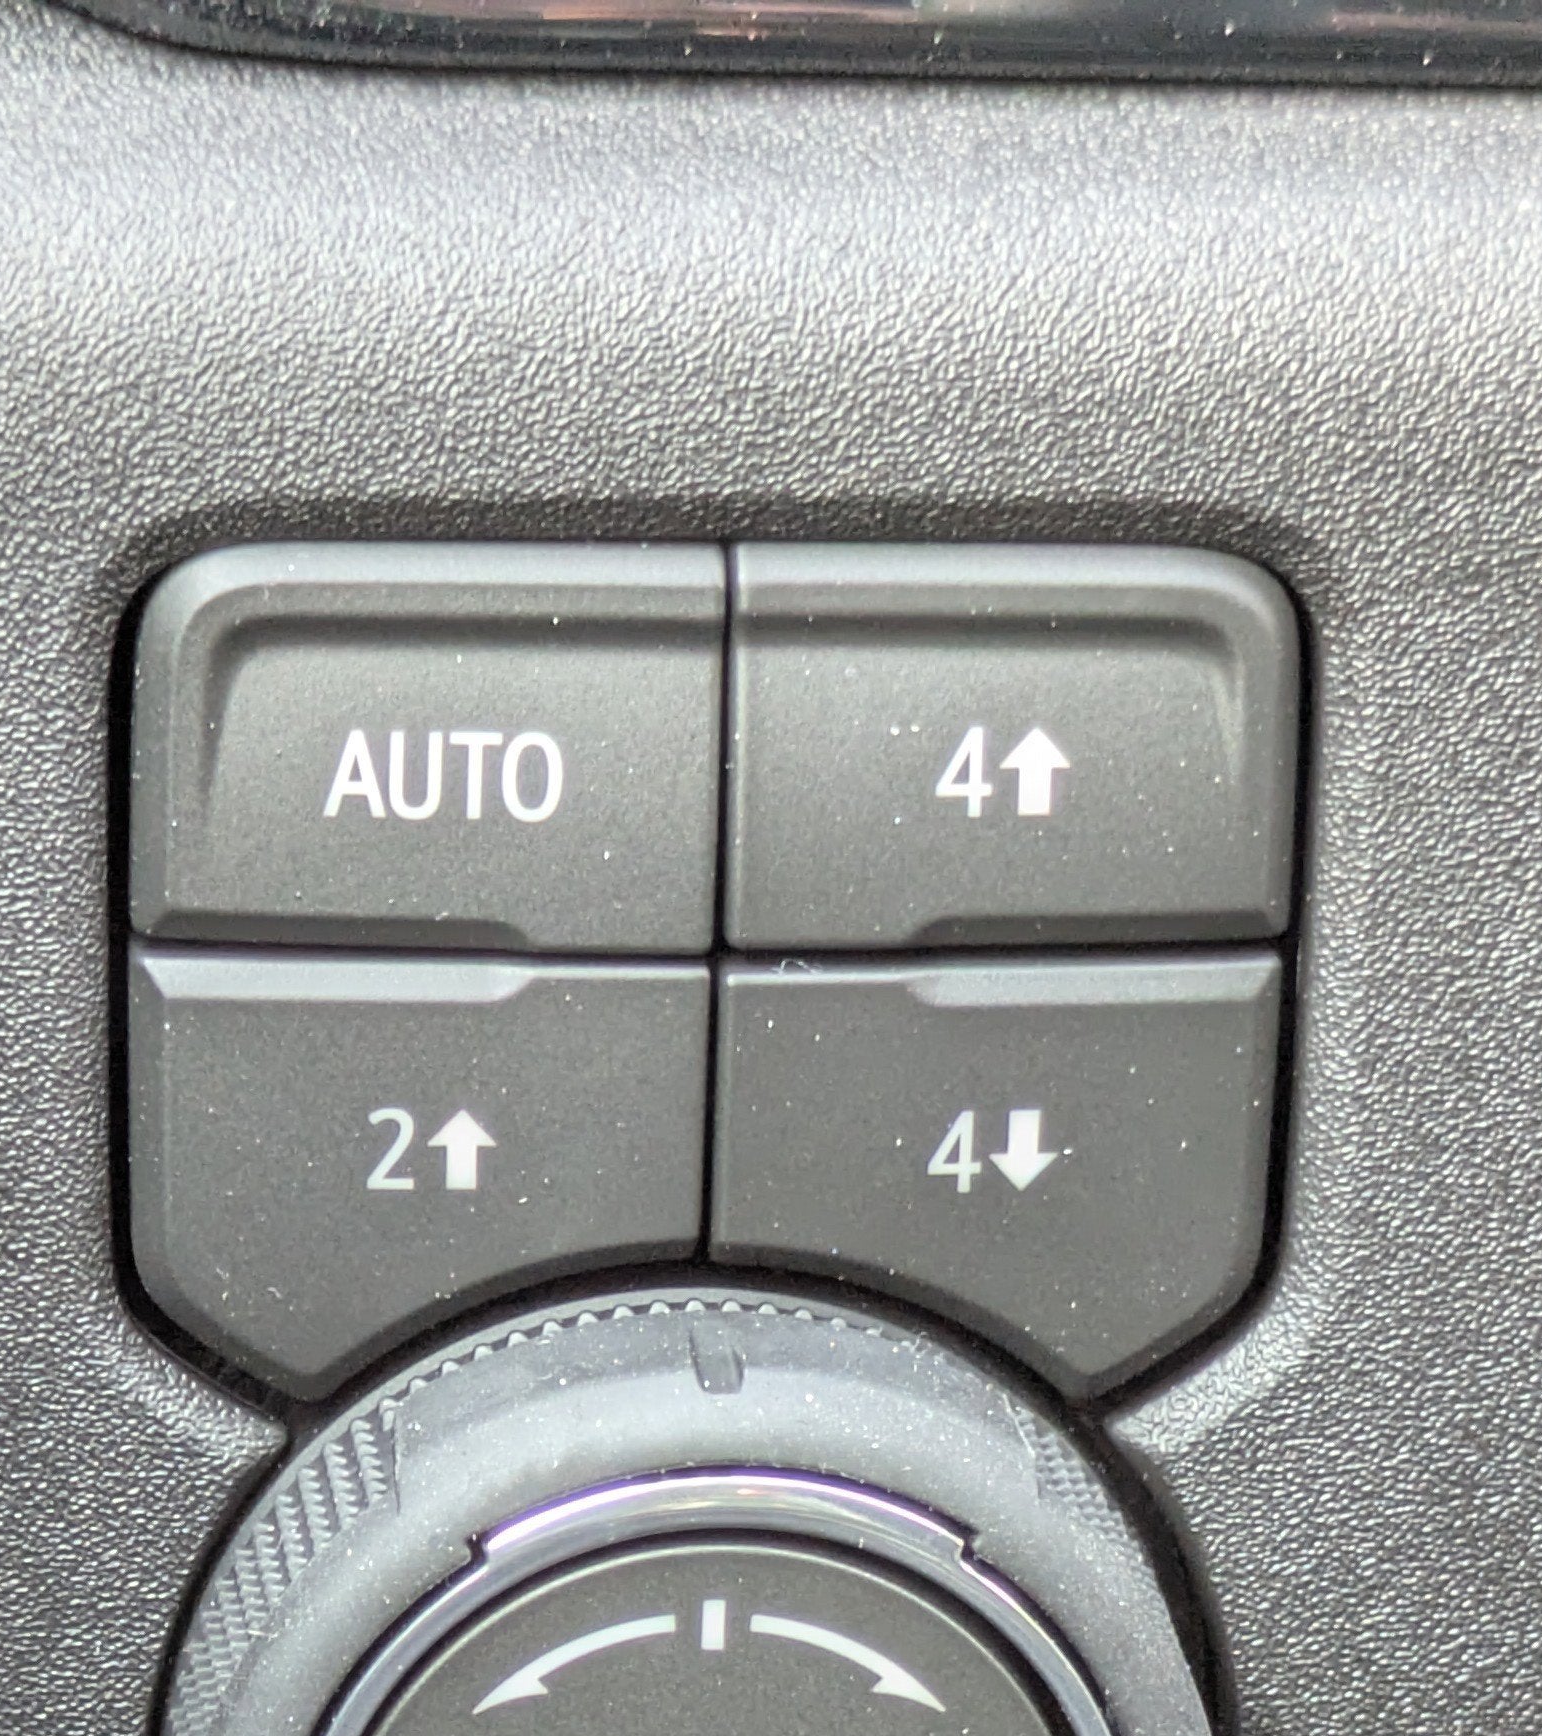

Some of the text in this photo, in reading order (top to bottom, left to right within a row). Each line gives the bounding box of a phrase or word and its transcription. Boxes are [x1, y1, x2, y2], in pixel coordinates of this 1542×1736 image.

[323, 728, 565, 823] AUTO
[935, 724, 994, 818] 4
[365, 1106, 416, 1191] 2
[926, 1109, 983, 1193] 4
